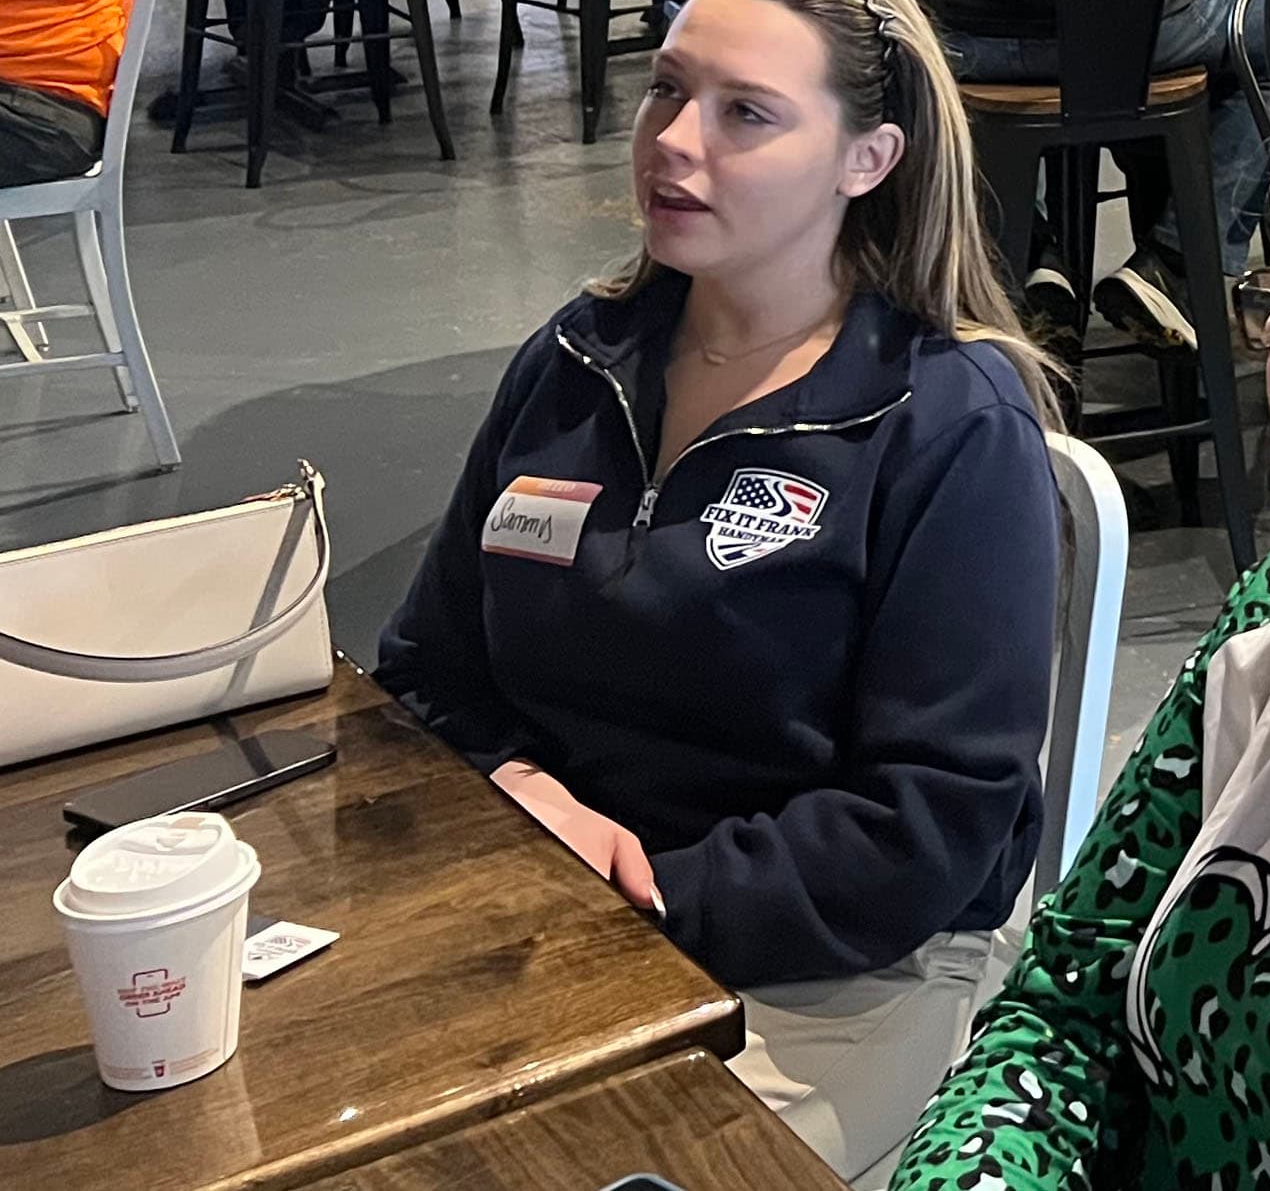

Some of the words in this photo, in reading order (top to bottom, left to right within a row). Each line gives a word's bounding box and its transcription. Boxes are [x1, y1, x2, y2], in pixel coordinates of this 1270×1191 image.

[704, 506, 736, 524] FIX
[735, 512, 757, 528] IT
[755, 517, 817, 537] FRANK
